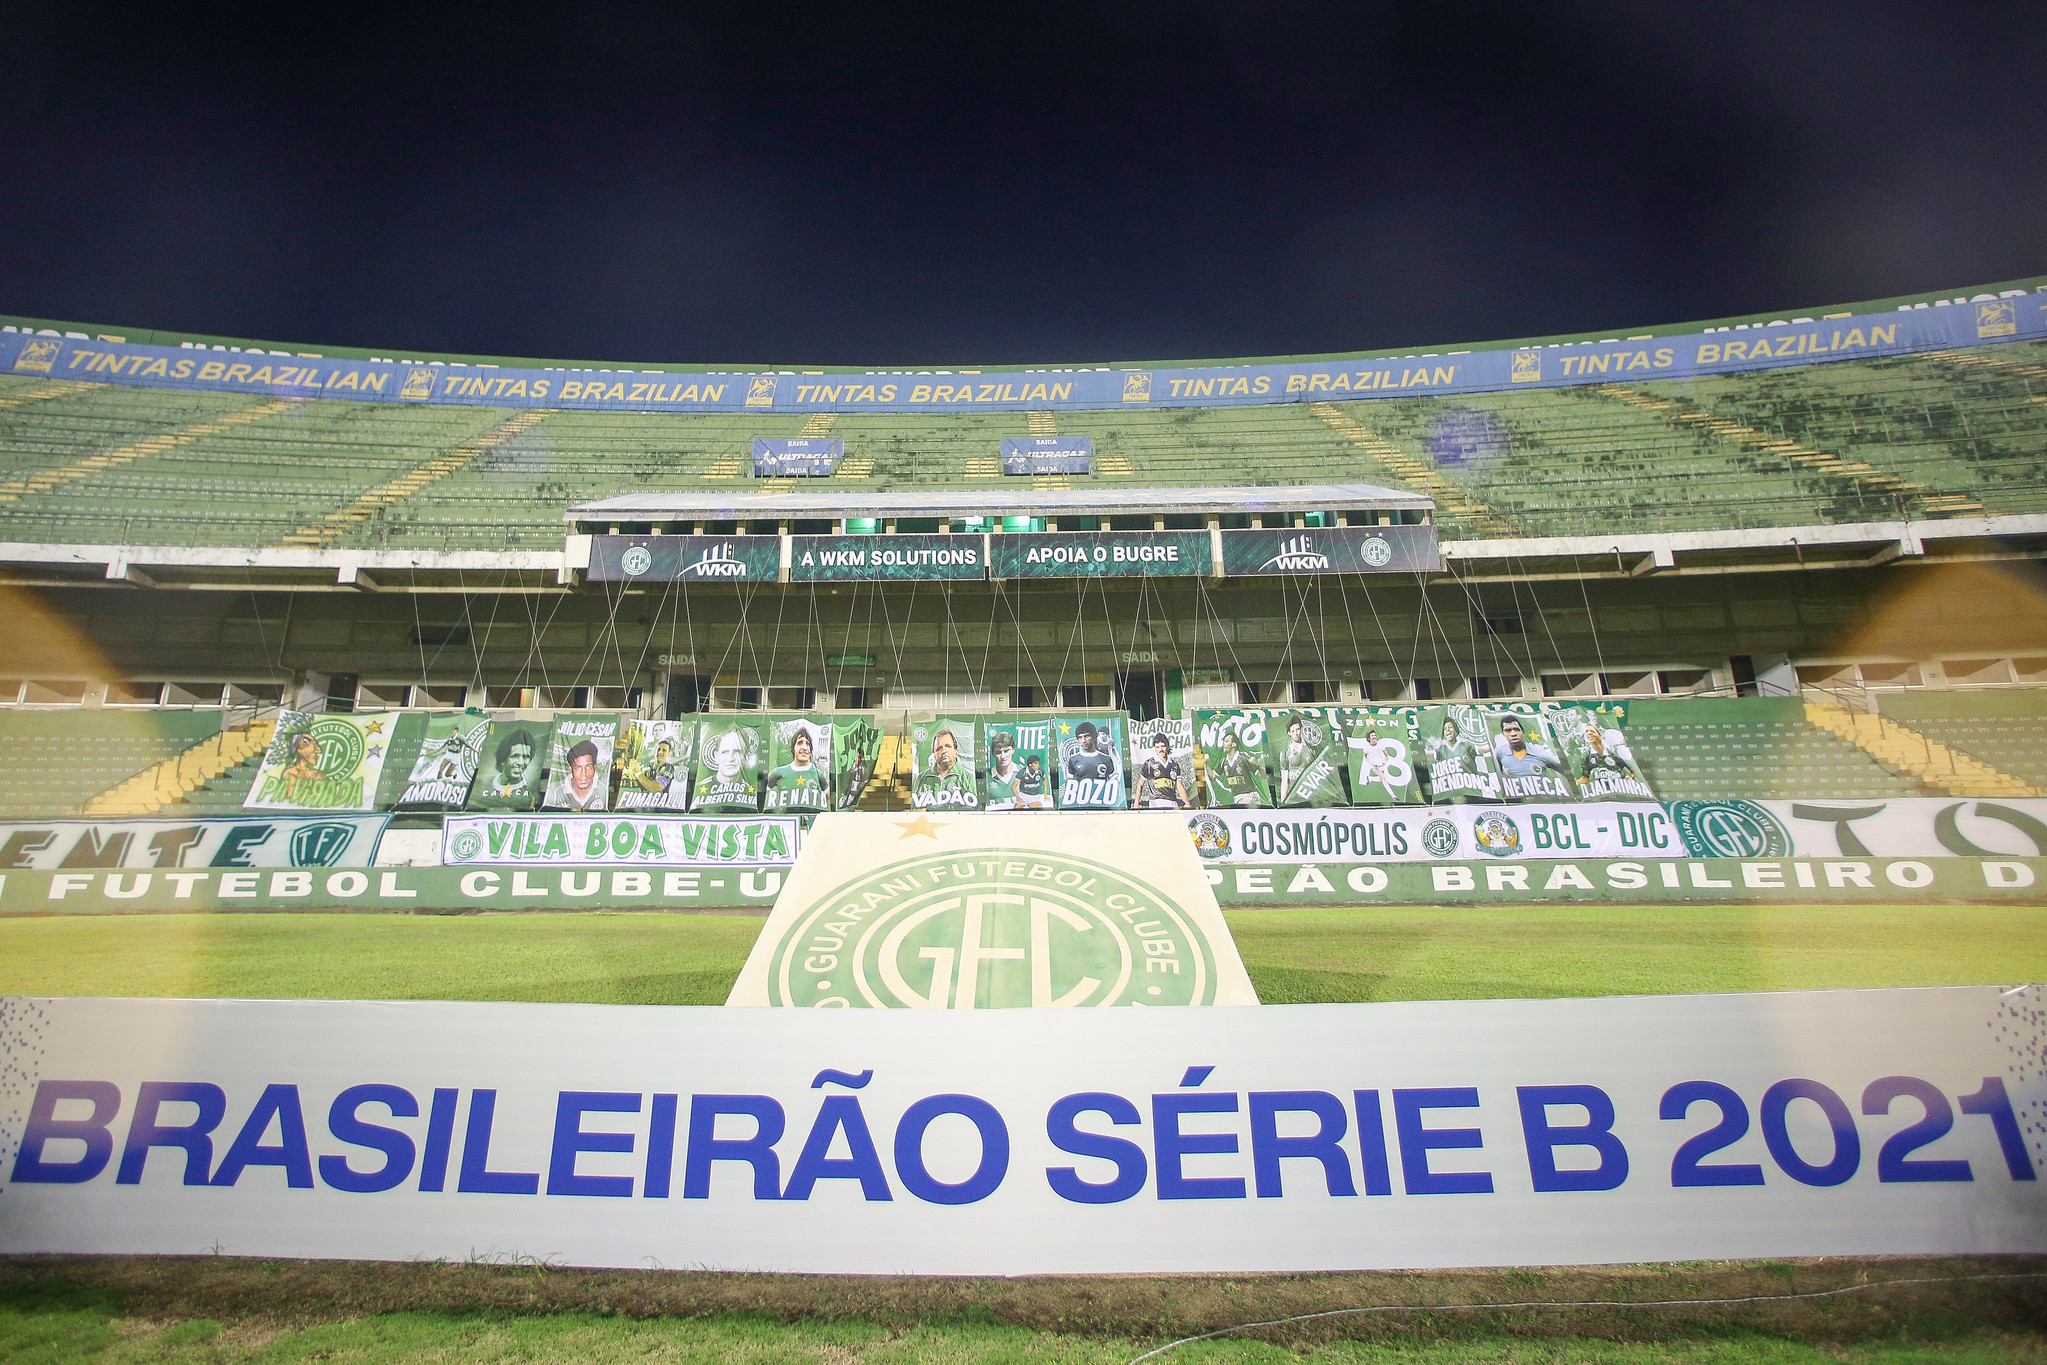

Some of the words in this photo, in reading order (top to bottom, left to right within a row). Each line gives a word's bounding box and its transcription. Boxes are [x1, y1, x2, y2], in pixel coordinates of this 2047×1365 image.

[1559, 347, 1674, 376] TINTAS
[1696, 323, 1896, 365] BRAZILIAN
[66, 349, 196, 380] TINTAS
[197, 362, 391, 392] BRAZILIAN
[1169, 376, 1271, 397] TINTAS
[1285, 365, 1456, 393] BRAZILIAN
[444, 376, 551, 398] TINTAS
[558, 381, 726, 403] BRAZILIAN
[796, 384, 898, 403] TINTAS
[908, 382, 1073, 403] BRAZILIAN
[1027, 451, 1087, 459] ULTRAGAZ
[801, 551, 815, 567] A
[819, 550, 868, 567] WKM
[870, 548, 978, 567] SOLUTIONS
[1025, 546, 1090, 564] APOIA
[1093, 546, 1108, 563] O
[1112, 545, 1179, 563] BUGRE
[1275, 555, 1329, 570] WKM
[697, 562, 747, 577] WKM
[658, 654, 697, 666] SAIDA
[1121, 651, 1160, 663] SAIDA
[557, 720, 586, 737] JÚLIO
[584, 721, 617, 738] CÉSAR
[1130, 719, 1183, 735] RICARDO
[1200, 715, 1263, 748] NETO
[1345, 717, 1400, 727] ZENON
[1016, 725, 1046, 750] TITE
[1431, 756, 1464, 779] JORGE
[711, 782, 747, 795] CARLOS
[1296, 760, 1334, 800] EVAIR
[1502, 777, 1570, 797] NENECA
[1580, 778, 1653, 799] DJALMINHA
[400, 781, 468, 807] AMOROSO
[618, 791, 686, 810] FUMAGALLI
[694, 792, 735, 806] ALBERTO
[735, 794, 758, 806] SILVA
[767, 789, 829, 809] RENATO
[912, 787, 978, 807] VADÃO
[1737, 803, 1776, 833] CLUBE
[1240, 815, 1409, 857] COSMÓPOLIS
[1530, 813, 1591, 849] BCL
[1616, 811, 1670, 849] DIC
[487, 820, 571, 859] VILA
[584, 820, 668, 860] BOA
[683, 822, 790, 862] VISTA
[48, 872, 418, 900] FUTEBOL
[1431, 860, 1935, 892] BRASILEIRO
[1980, 861, 2036, 888] D
[803, 873, 920, 973] GUARANI
[930, 860, 1098, 898] FUTEBOL
[1105, 893, 1180, 975] CLUBE
[8, 1067, 1012, 1205] BRASILEIRÃO
[1044, 1065, 1496, 1205] SÉRIE
[1516, 1083, 1631, 1194] B
[1657, 1074, 2038, 1189] 2021
